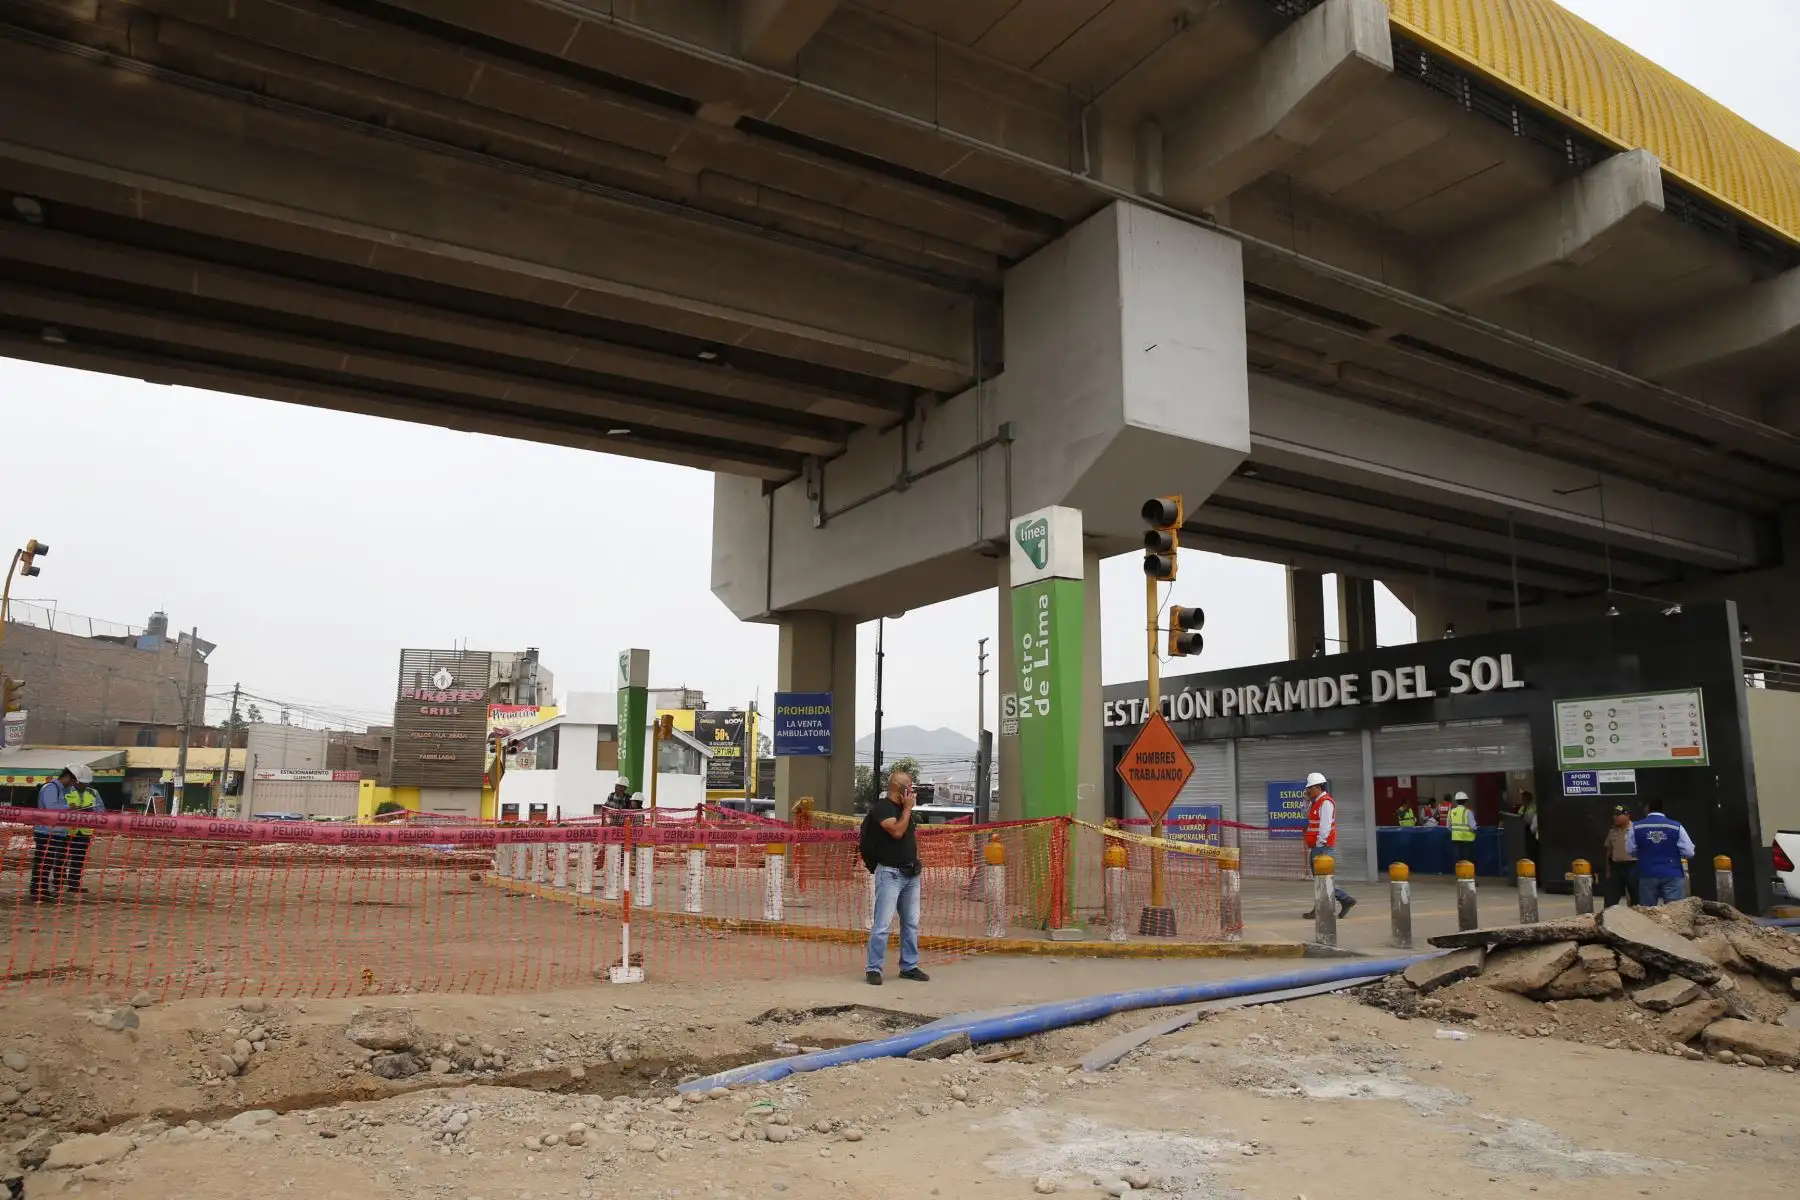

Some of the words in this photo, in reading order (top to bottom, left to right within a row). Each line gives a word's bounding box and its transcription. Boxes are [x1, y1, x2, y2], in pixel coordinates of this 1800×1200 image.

[1037, 538, 1046, 563] 1
[1033, 594, 1049, 668] Lima
[1019, 633, 1033, 718] Metro
[1222, 674, 1360, 717] PIRÁMIDE
[1371, 665, 1437, 703] DEL
[1449, 653, 1525, 694] SOL
[1034, 680, 1050, 716] de
[420, 706, 461, 716] GRILL
[777, 705, 831, 715] PROHIBIDA
[1005, 696, 1016, 717] S
[786, 720, 796, 728] LA
[797, 720, 822, 728] VENTA
[776, 729, 831, 737] AMBULATORIA
[1136, 751, 1176, 764] HOMBRES
[1128, 768, 1183, 781] TRABAJANDO
[1280, 790, 1306, 799] ESTACI
[1282, 801, 1304, 809] CERRA
[1269, 811, 1305, 819] TEMPORAL
[57, 812, 109, 824] OBRAS
[130, 816, 178, 829] PELIGRO
[208, 822, 254, 835] OBRAS
[272, 826, 314, 837] PELIGRO
[341, 829, 381, 839] OBRAS
[398, 829, 435, 839] PELIGRO
[459, 829, 496, 840] OBRAS
[510, 829, 544, 839] PELIGRO
[566, 829, 598, 838] OBRAS
[611, 829, 643, 838] PELRO
[663, 829, 695, 839] OBRAS
[708, 831, 738, 841] PELIGRO
[756, 832, 785, 841] OBRAS
[841, 833, 860, 842] OBRA
[1196, 847, 1221, 856] PELIGRO
